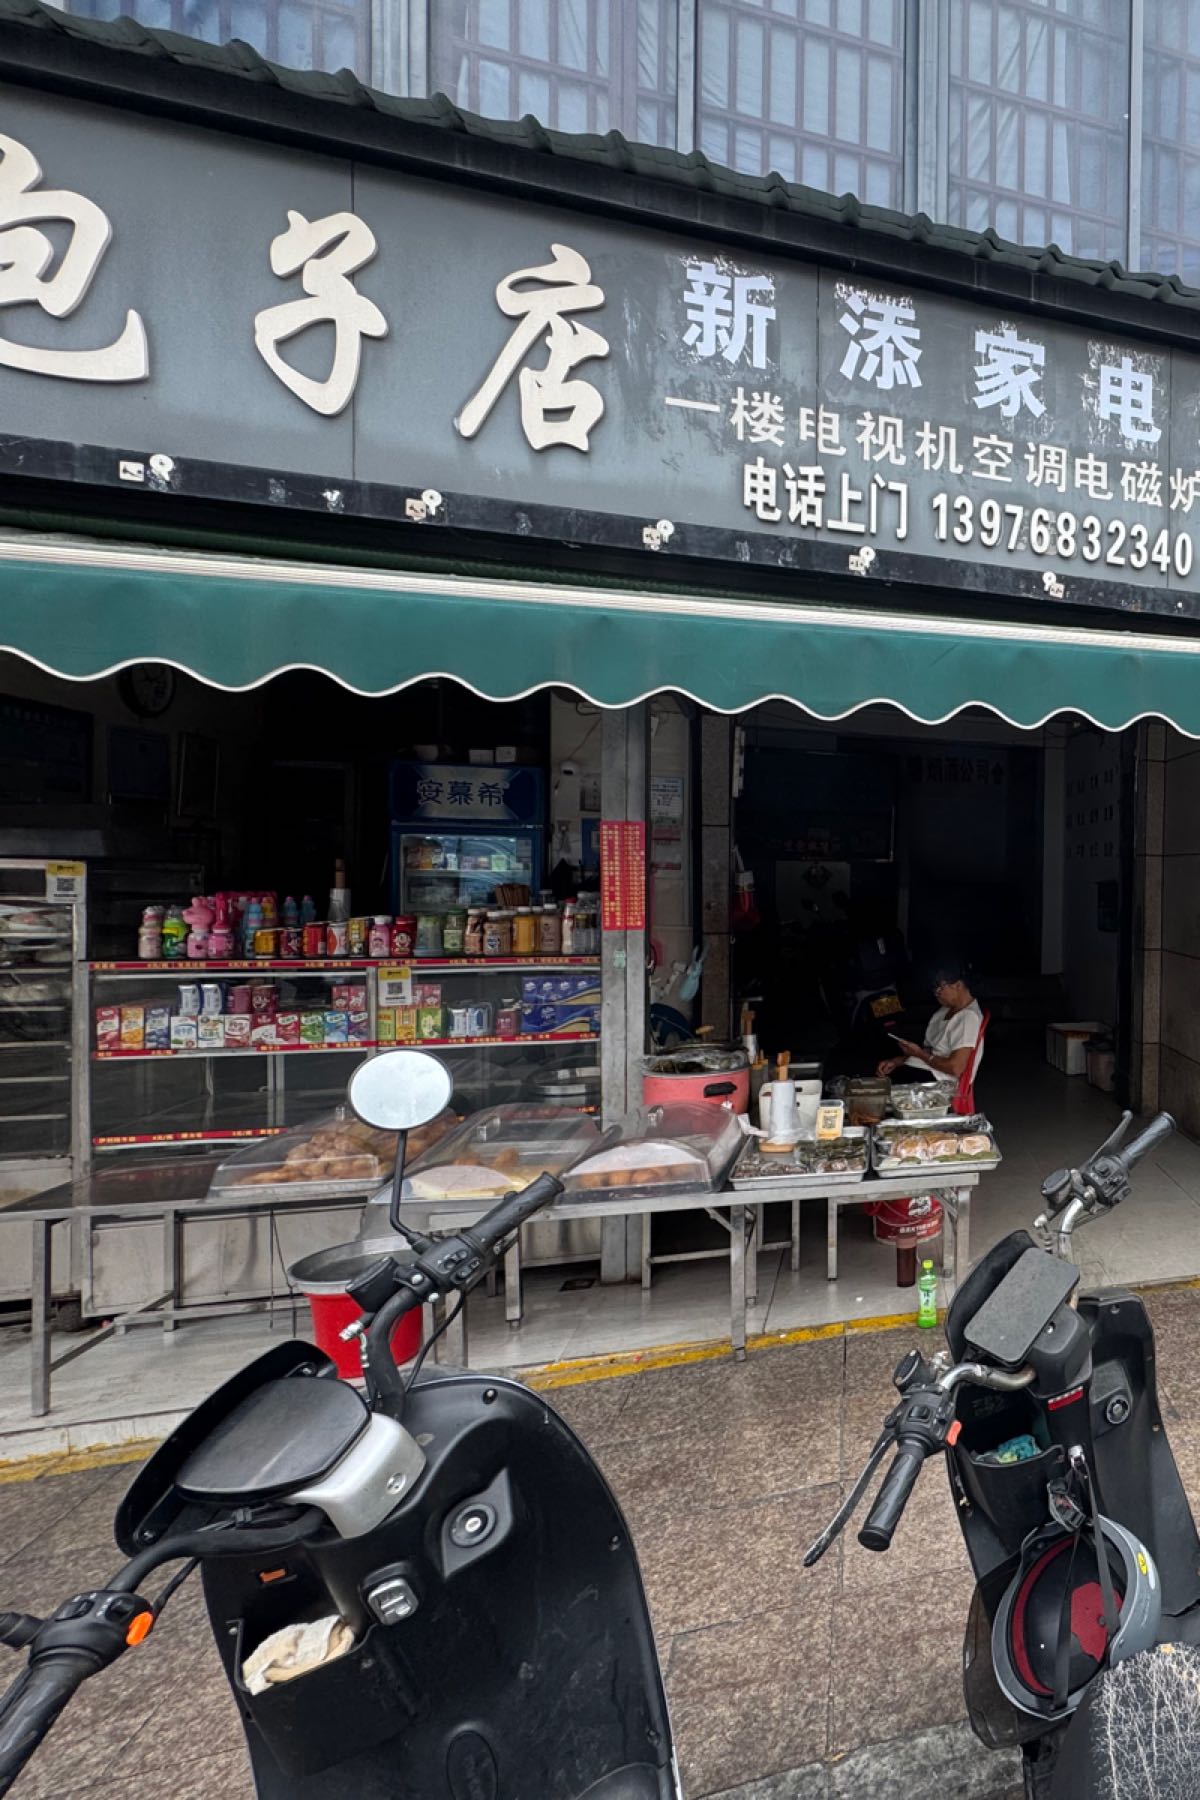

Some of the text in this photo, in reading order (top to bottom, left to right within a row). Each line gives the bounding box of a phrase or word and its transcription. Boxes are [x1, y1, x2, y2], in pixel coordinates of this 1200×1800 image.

[742, 456, 1194, 577] 电话上门 13976832340
[417, 779, 504, 807] 安慕希
